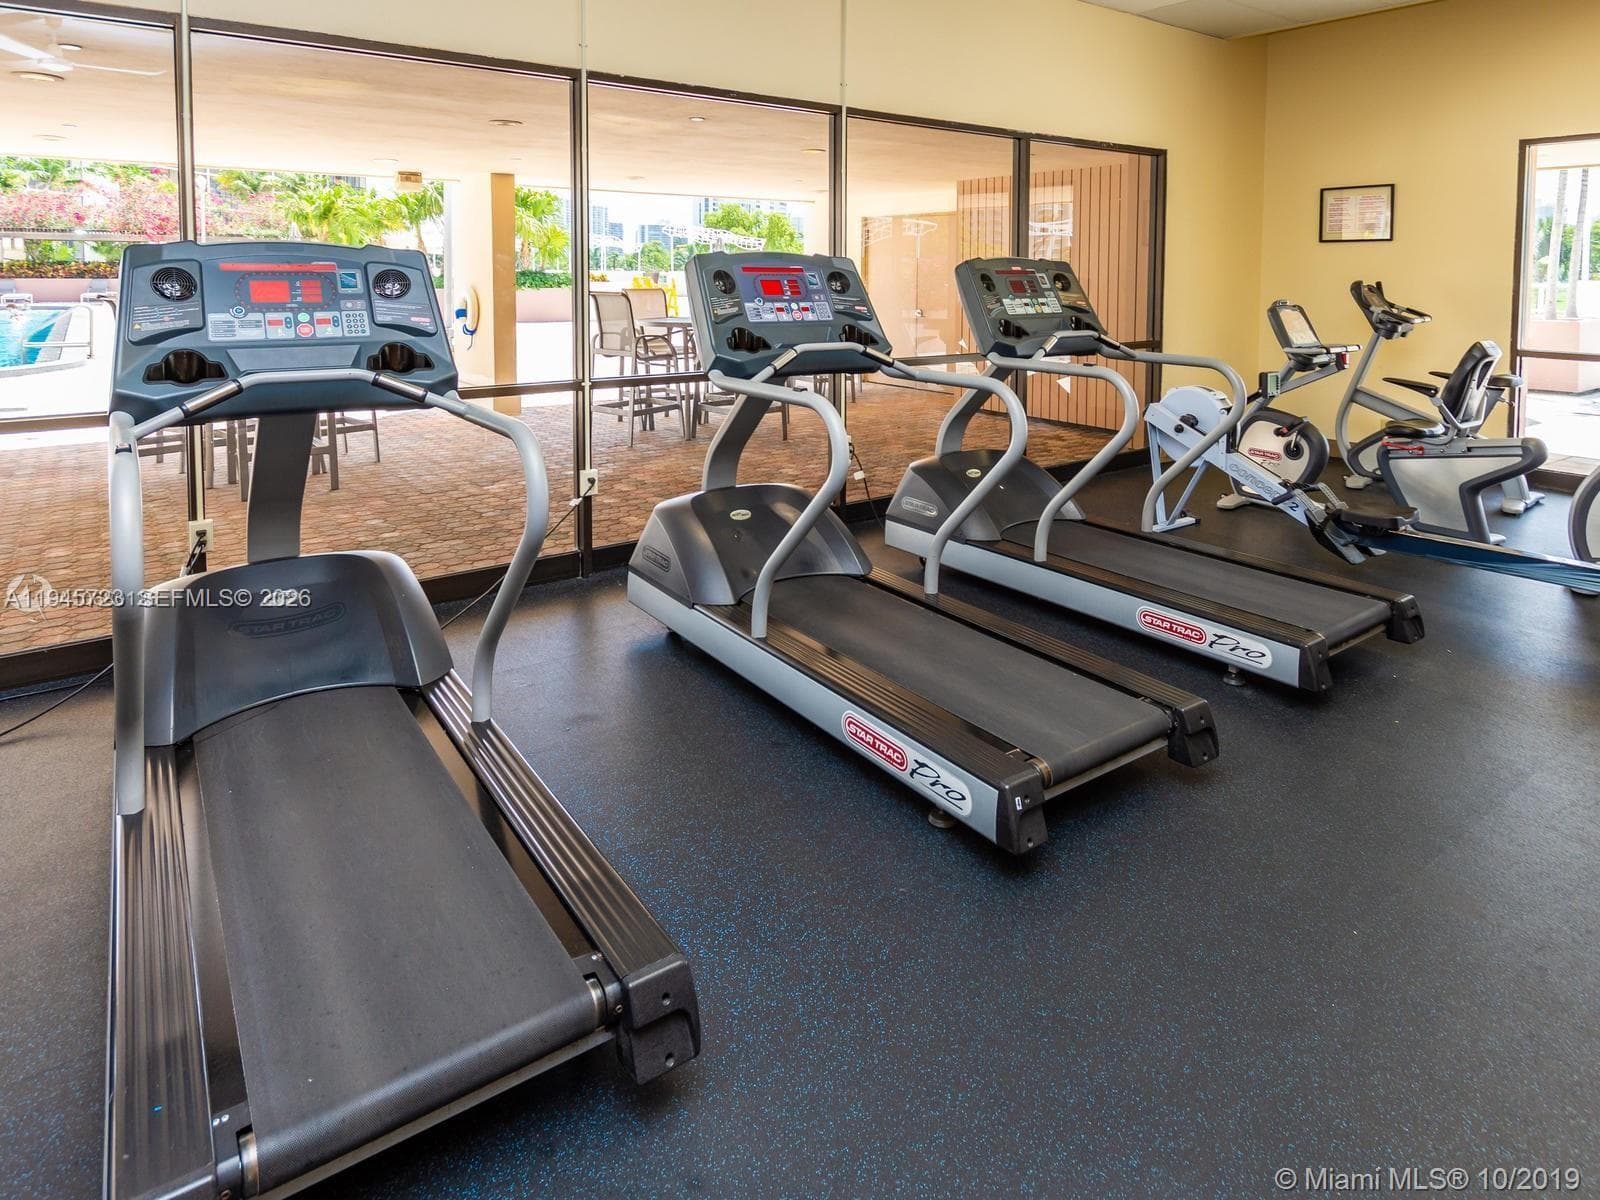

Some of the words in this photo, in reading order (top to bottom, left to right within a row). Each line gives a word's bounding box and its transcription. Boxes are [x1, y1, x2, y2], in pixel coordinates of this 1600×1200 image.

[1288, 501, 1300, 512] 2
[1144, 615, 1170, 629] STAR
[1171, 624, 1202, 639] TRAC
[1208, 633, 1266, 659] Pro
[849, 724, 874, 745] STAR
[874, 739, 904, 763] TRAC
[909, 759, 967, 801] Pro
